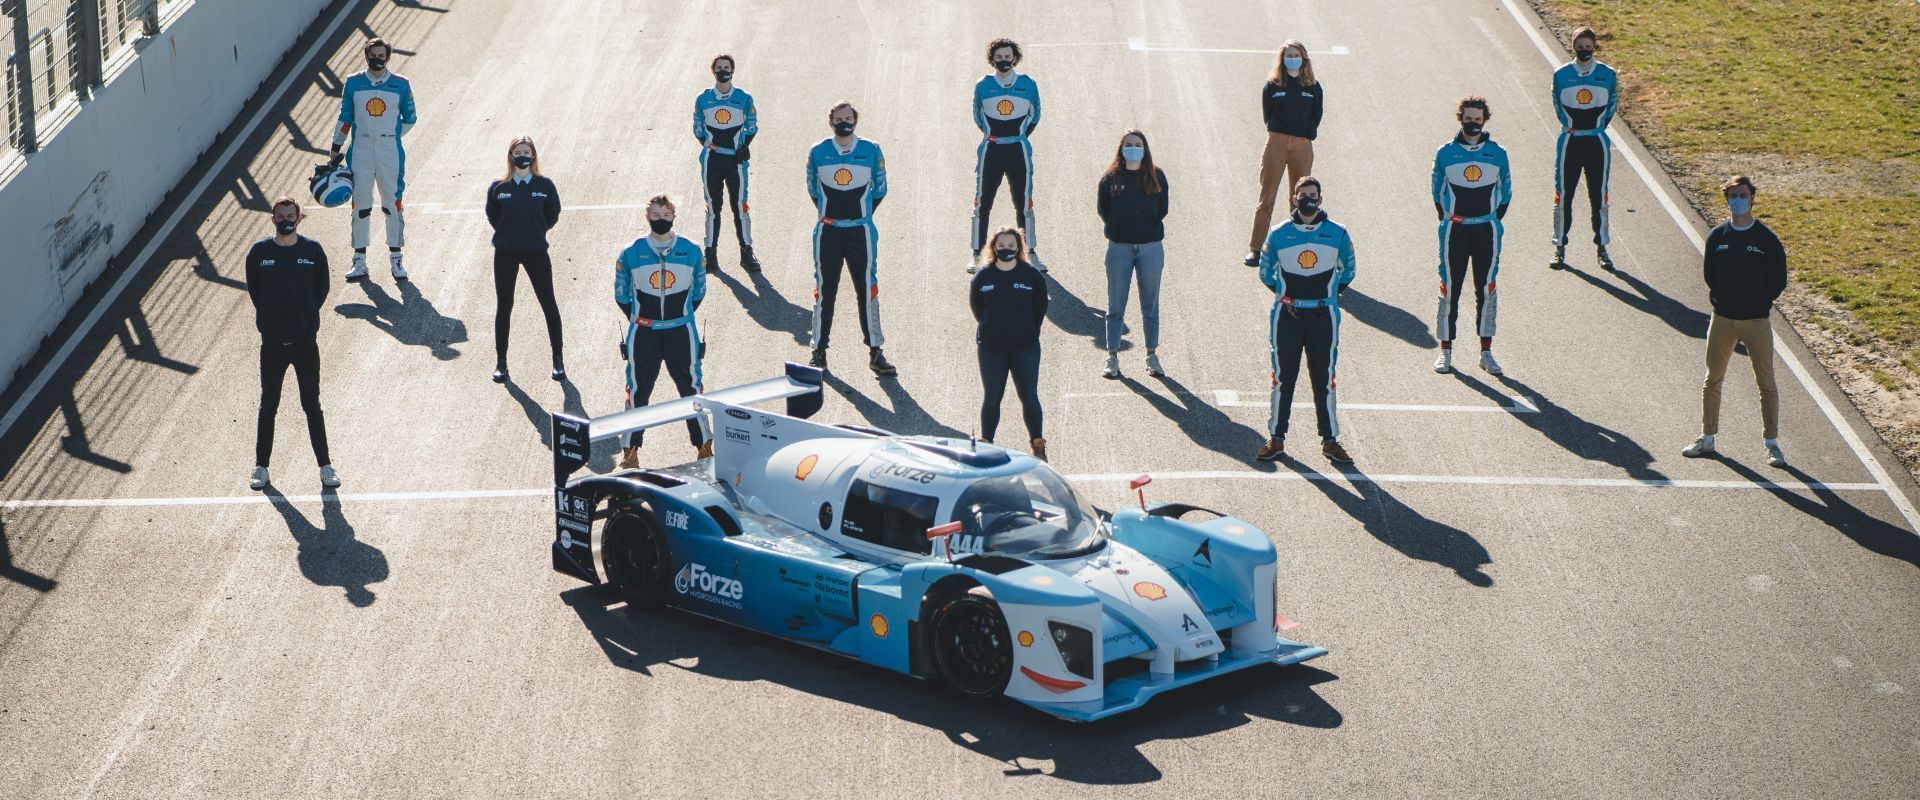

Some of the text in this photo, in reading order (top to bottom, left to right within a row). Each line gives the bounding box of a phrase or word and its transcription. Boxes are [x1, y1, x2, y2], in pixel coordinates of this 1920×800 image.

[884, 462, 936, 483] Forze
[950, 533, 984, 556] 444
[690, 562, 743, 600] Forze
[690, 591, 743, 610] HYDROGEN RACING
